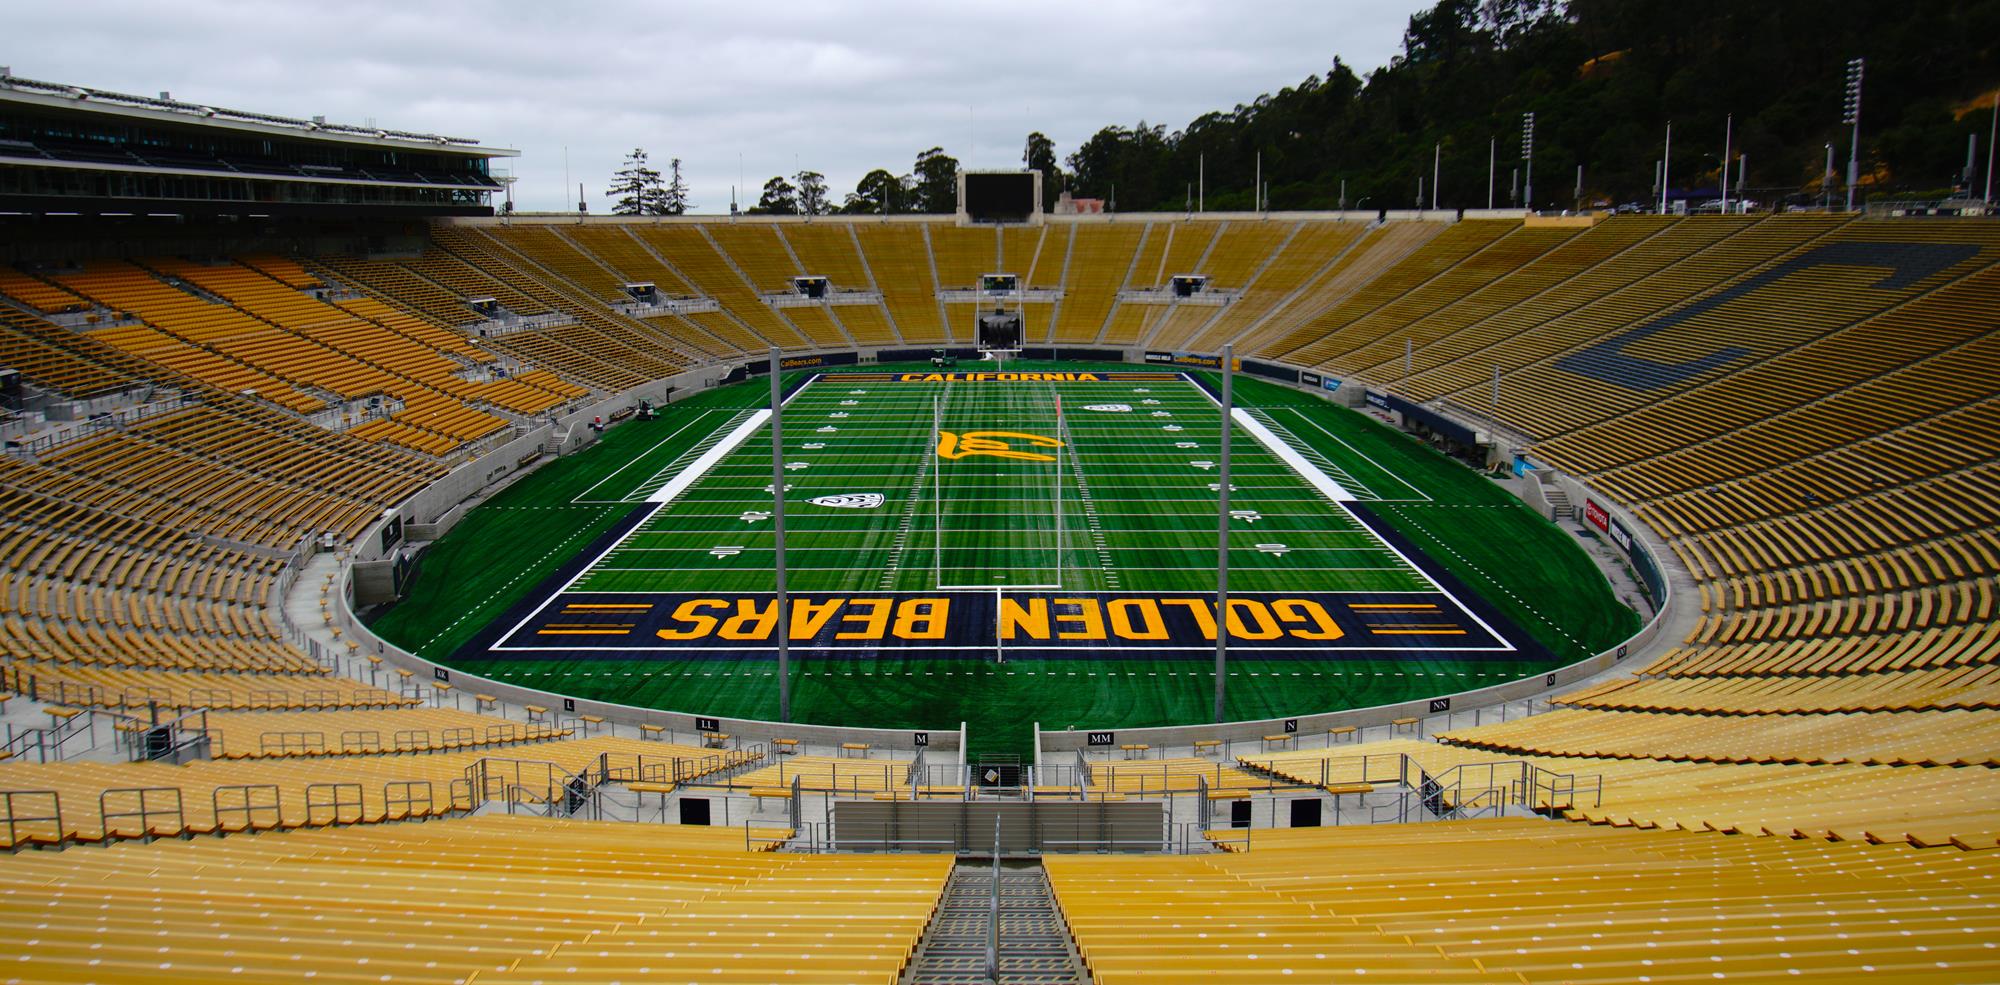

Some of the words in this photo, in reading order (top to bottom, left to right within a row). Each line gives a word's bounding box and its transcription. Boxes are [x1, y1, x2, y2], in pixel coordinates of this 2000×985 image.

[900, 372, 1099, 382] CALIFORNIA
[655, 598, 950, 641] BEARS
[1000, 598, 1346, 641] GOLDEN
[1433, 700, 1447, 711] NN
[701, 719, 714, 729] LL
[1287, 721, 1296, 731] N
[916, 734, 926, 744] M
[1091, 734, 1111, 743] MM
